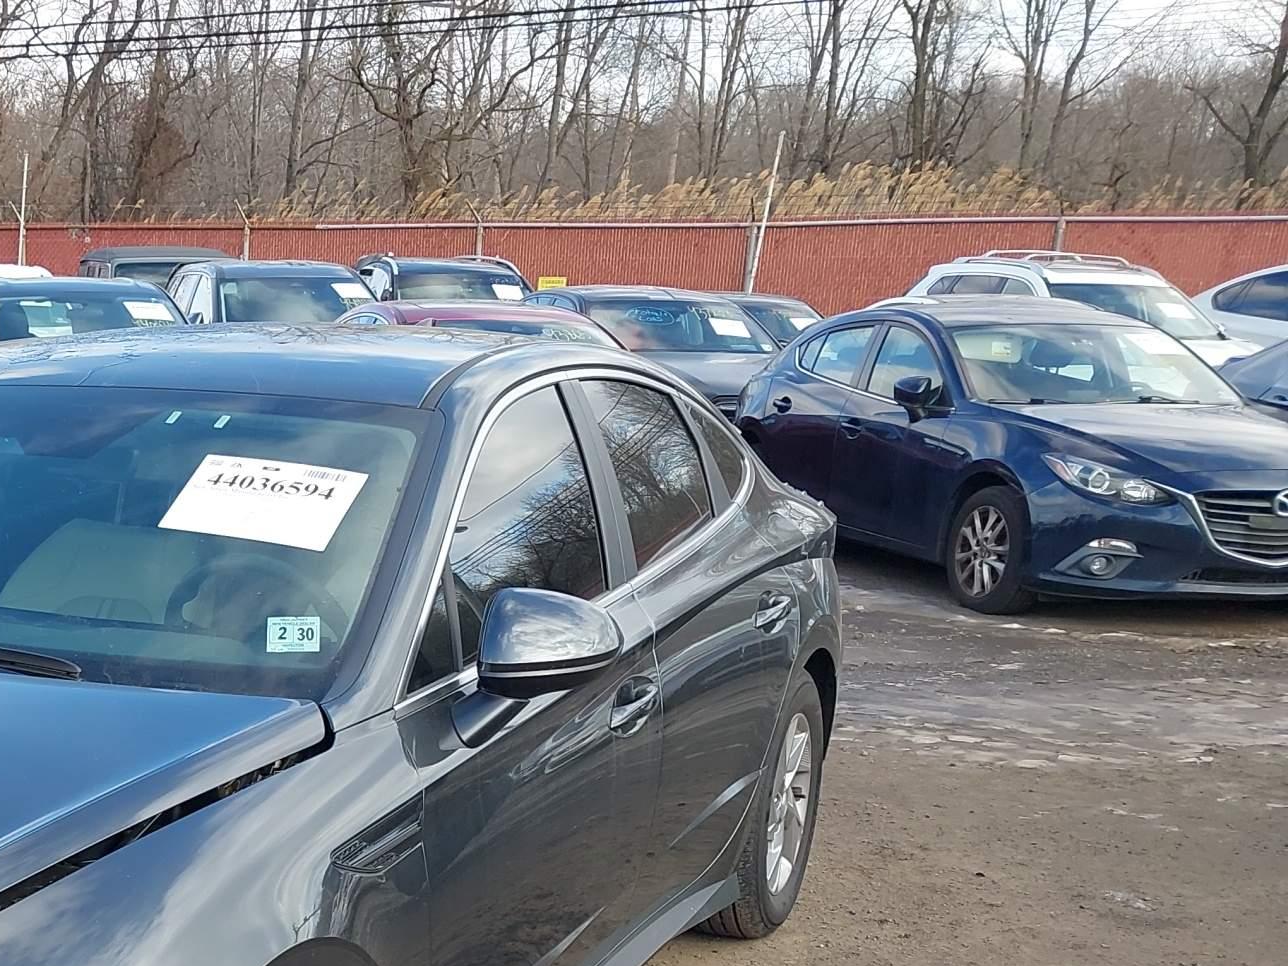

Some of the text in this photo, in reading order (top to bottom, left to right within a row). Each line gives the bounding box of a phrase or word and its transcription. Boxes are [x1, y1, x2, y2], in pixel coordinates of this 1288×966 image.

[207, 472, 335, 500] 44036594
[277, 626, 314, 641] 2 30
